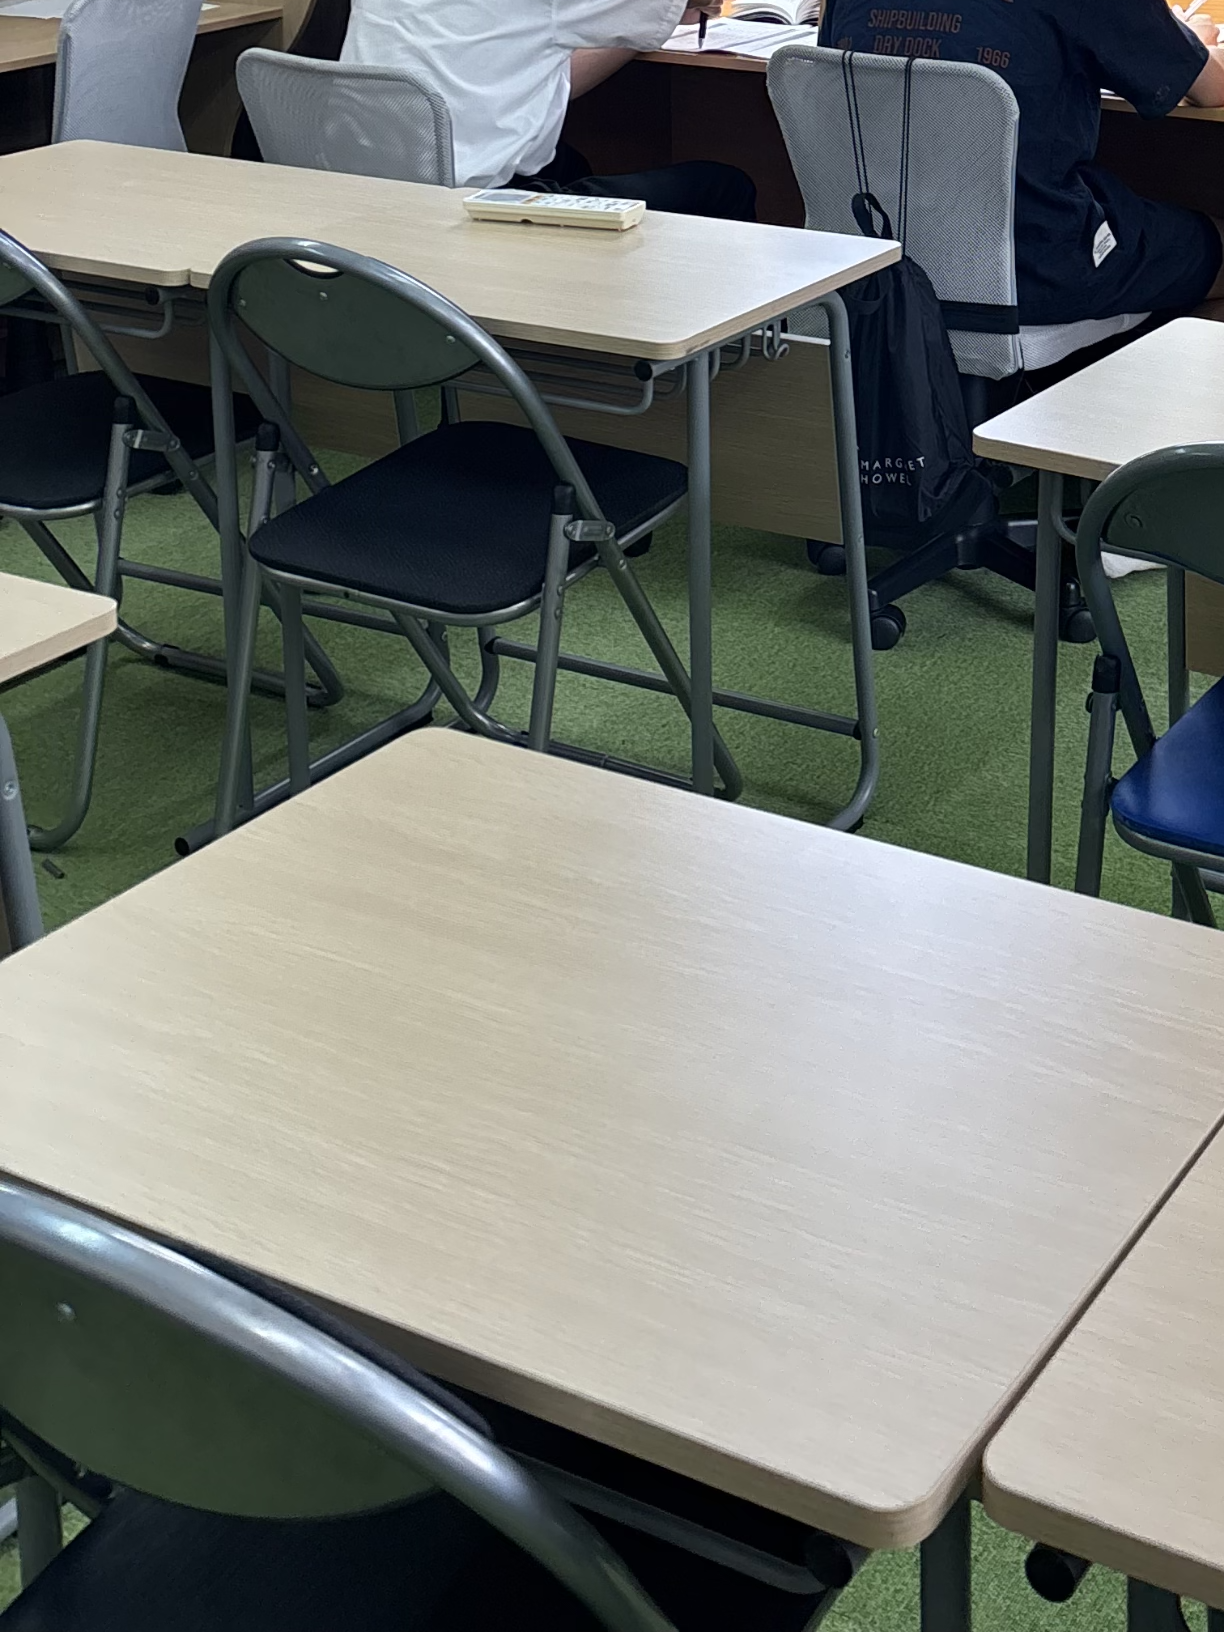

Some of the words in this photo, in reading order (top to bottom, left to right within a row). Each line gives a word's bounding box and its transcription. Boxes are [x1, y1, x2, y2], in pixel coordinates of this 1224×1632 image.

[868, 9, 962, 33] SHIPBUILDING
[874, 35, 900, 54] DRY
[905, 36, 942, 58] DOCK
[976, 46, 1010, 68] 1966
[860, 456, 925, 471] MARGET
[860, 472, 912, 486] HOWEL
